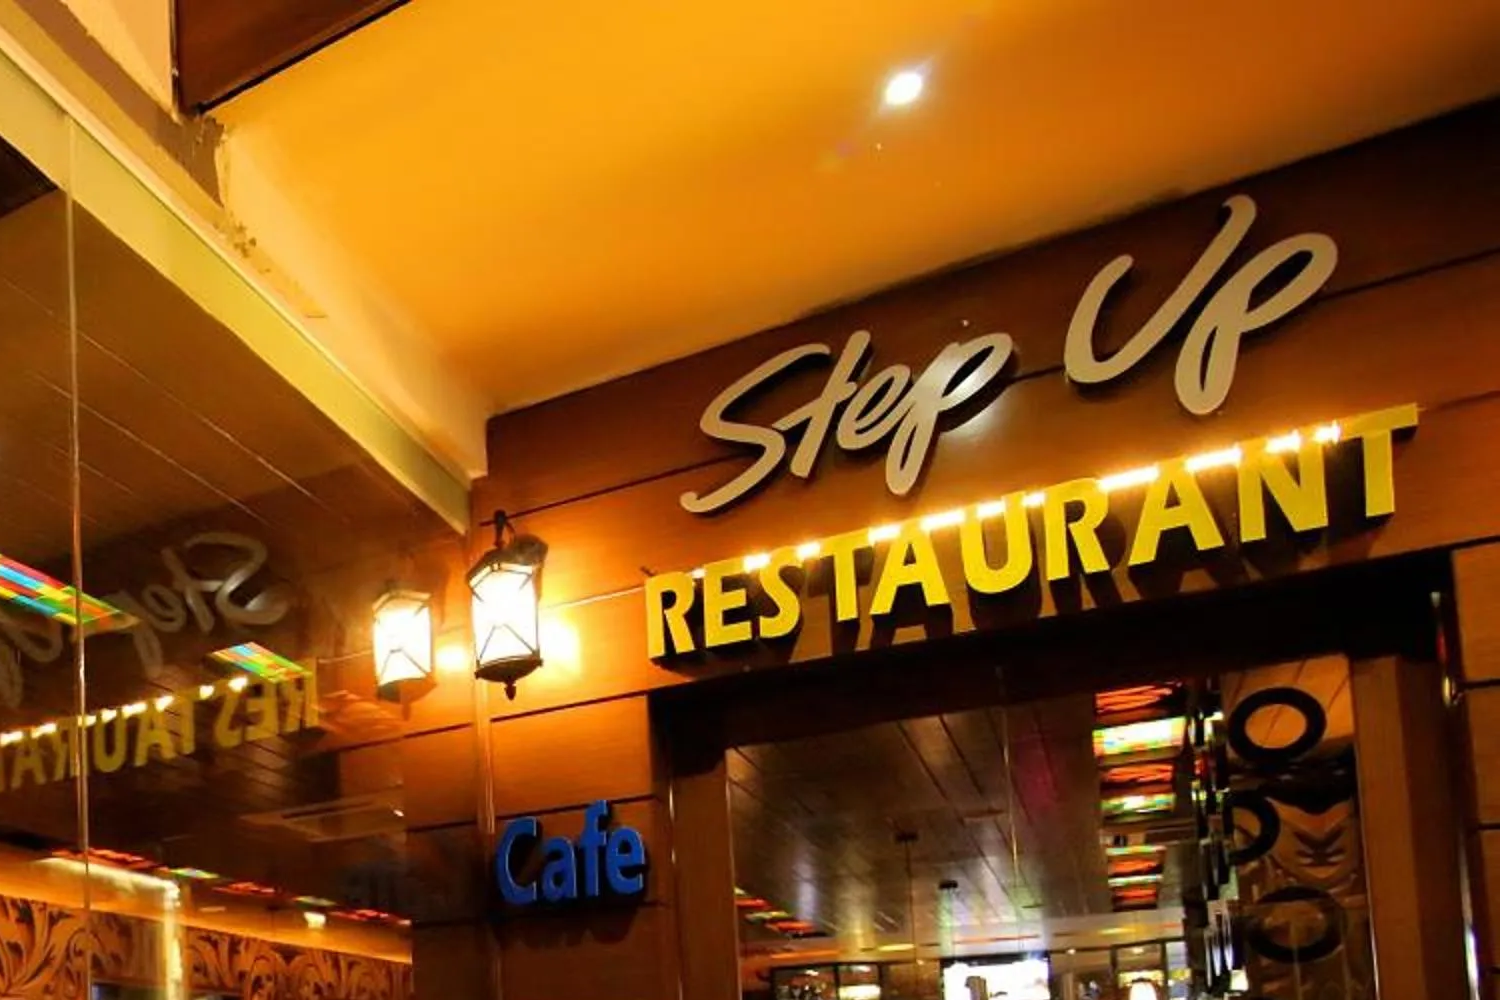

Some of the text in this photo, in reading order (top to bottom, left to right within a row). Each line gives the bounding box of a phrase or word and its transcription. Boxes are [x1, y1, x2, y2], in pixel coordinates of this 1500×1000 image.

[679, 194, 1338, 513] Step Up
[646, 403, 1419, 660] RESTAURANT
[496, 799, 647, 906] Cafe
